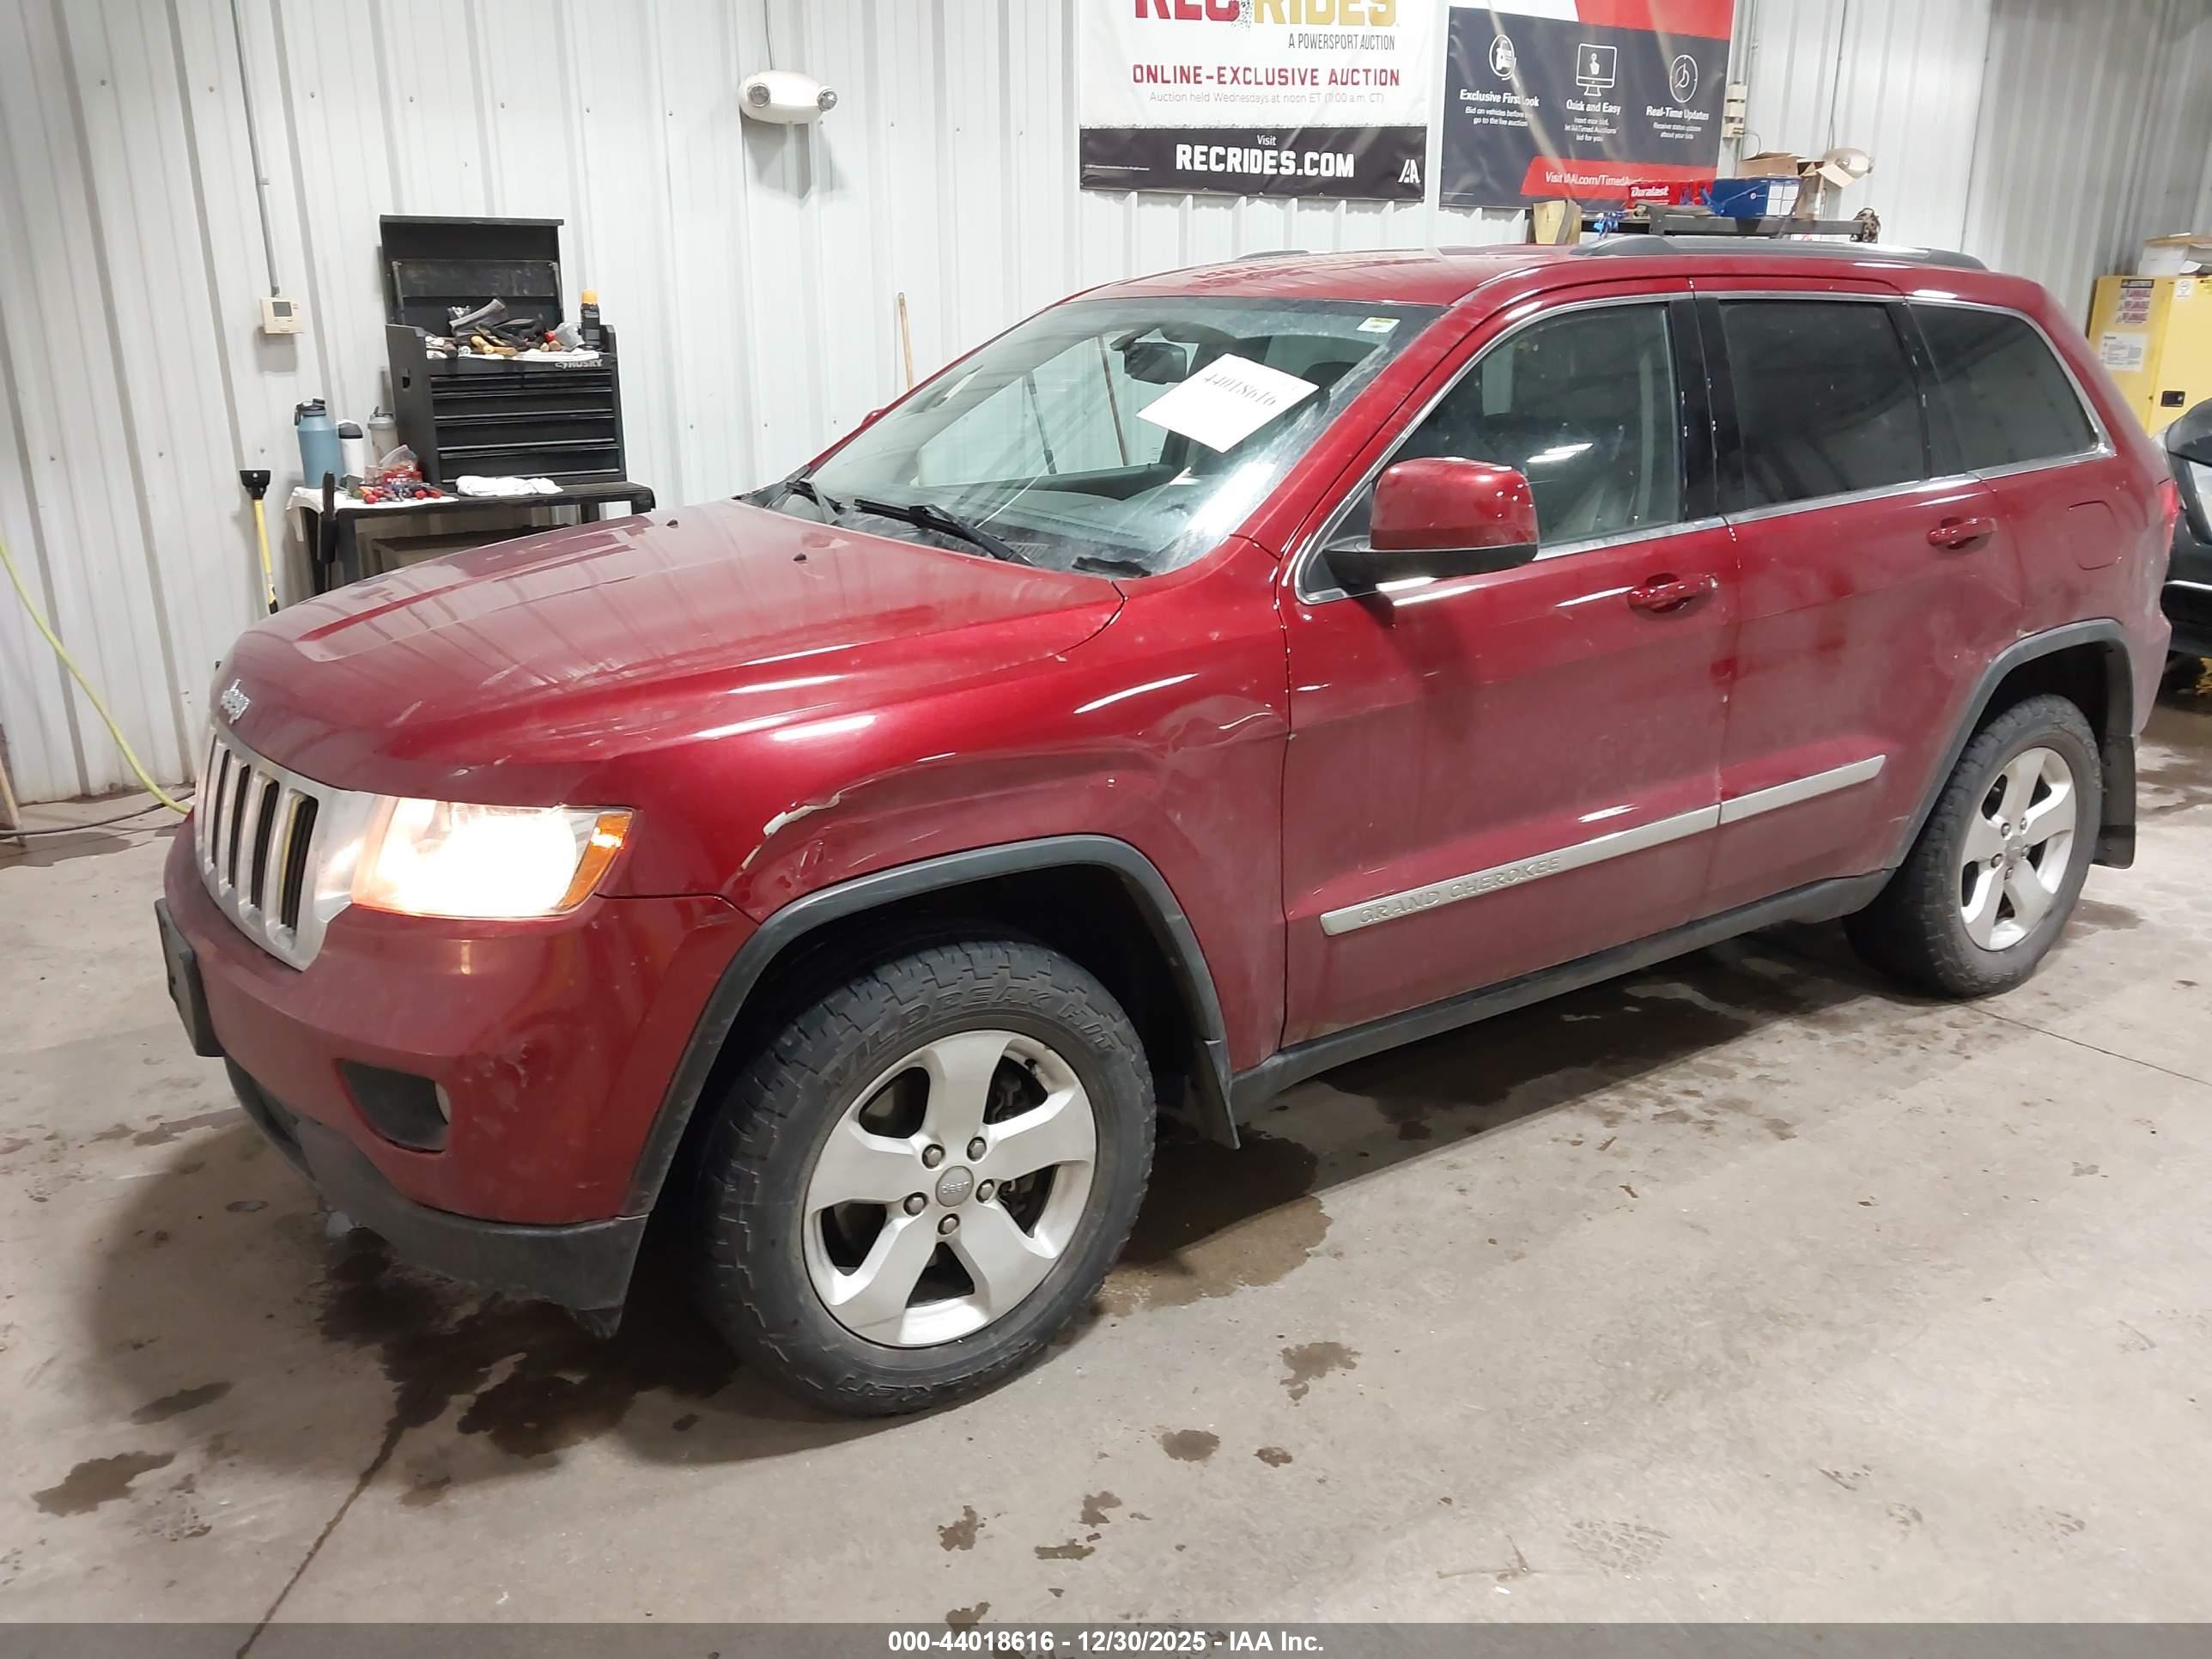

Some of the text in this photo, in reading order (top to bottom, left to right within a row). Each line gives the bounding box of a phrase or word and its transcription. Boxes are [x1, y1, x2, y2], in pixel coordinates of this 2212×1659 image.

[1288, 33, 1395, 51] A POWERSPORT AUCTION
[1133, 64, 1400, 86] ONLINE-EXCLUSIVE AUCTION
[1150, 91, 1187, 102] Auction
[1190, 92, 1210, 102] held
[1460, 88, 1501, 103] Exclusive
[1566, 99, 1621, 115] Quick and Easy
[1646, 106, 1683, 118] Real-Time
[1256, 134, 1277, 146] Visit
[1176, 144, 1354, 179] RECRIDES.COM
[1546, 172, 1562, 184] Visit
[1631, 185, 1669, 197] Duralast
[1359, 857, 1560, 925] GRAND CHEROKEE
